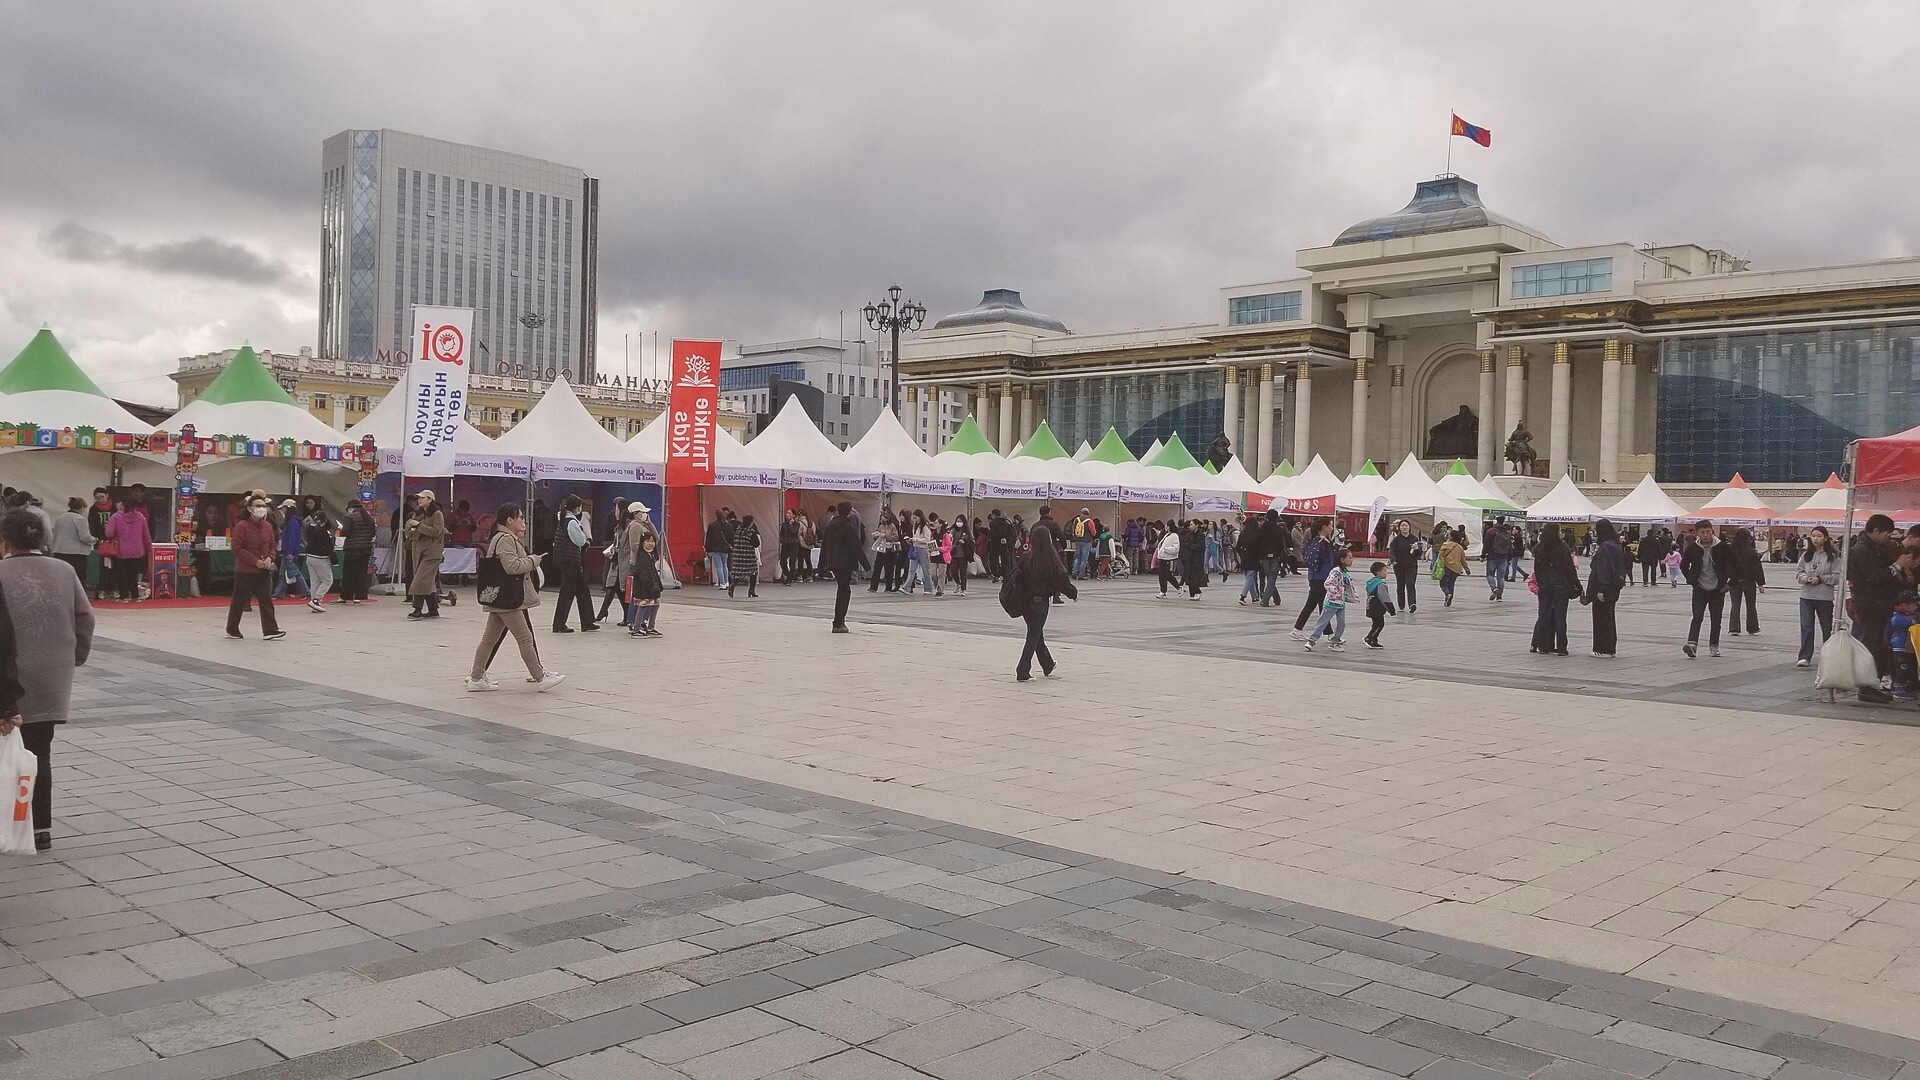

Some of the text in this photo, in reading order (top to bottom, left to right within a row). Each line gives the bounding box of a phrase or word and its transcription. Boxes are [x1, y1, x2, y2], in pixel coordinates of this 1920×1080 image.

[594, 372, 672, 392] МАНДУУ
[411, 383, 431, 445] ОЮУНЫ
[423, 372, 448, 457] ЧАДВАРЫН
[443, 389, 462, 443] IQ ТӨВ
[454, 460, 481, 468] ДВАРЫН
[728, 473, 758, 483] publishing
